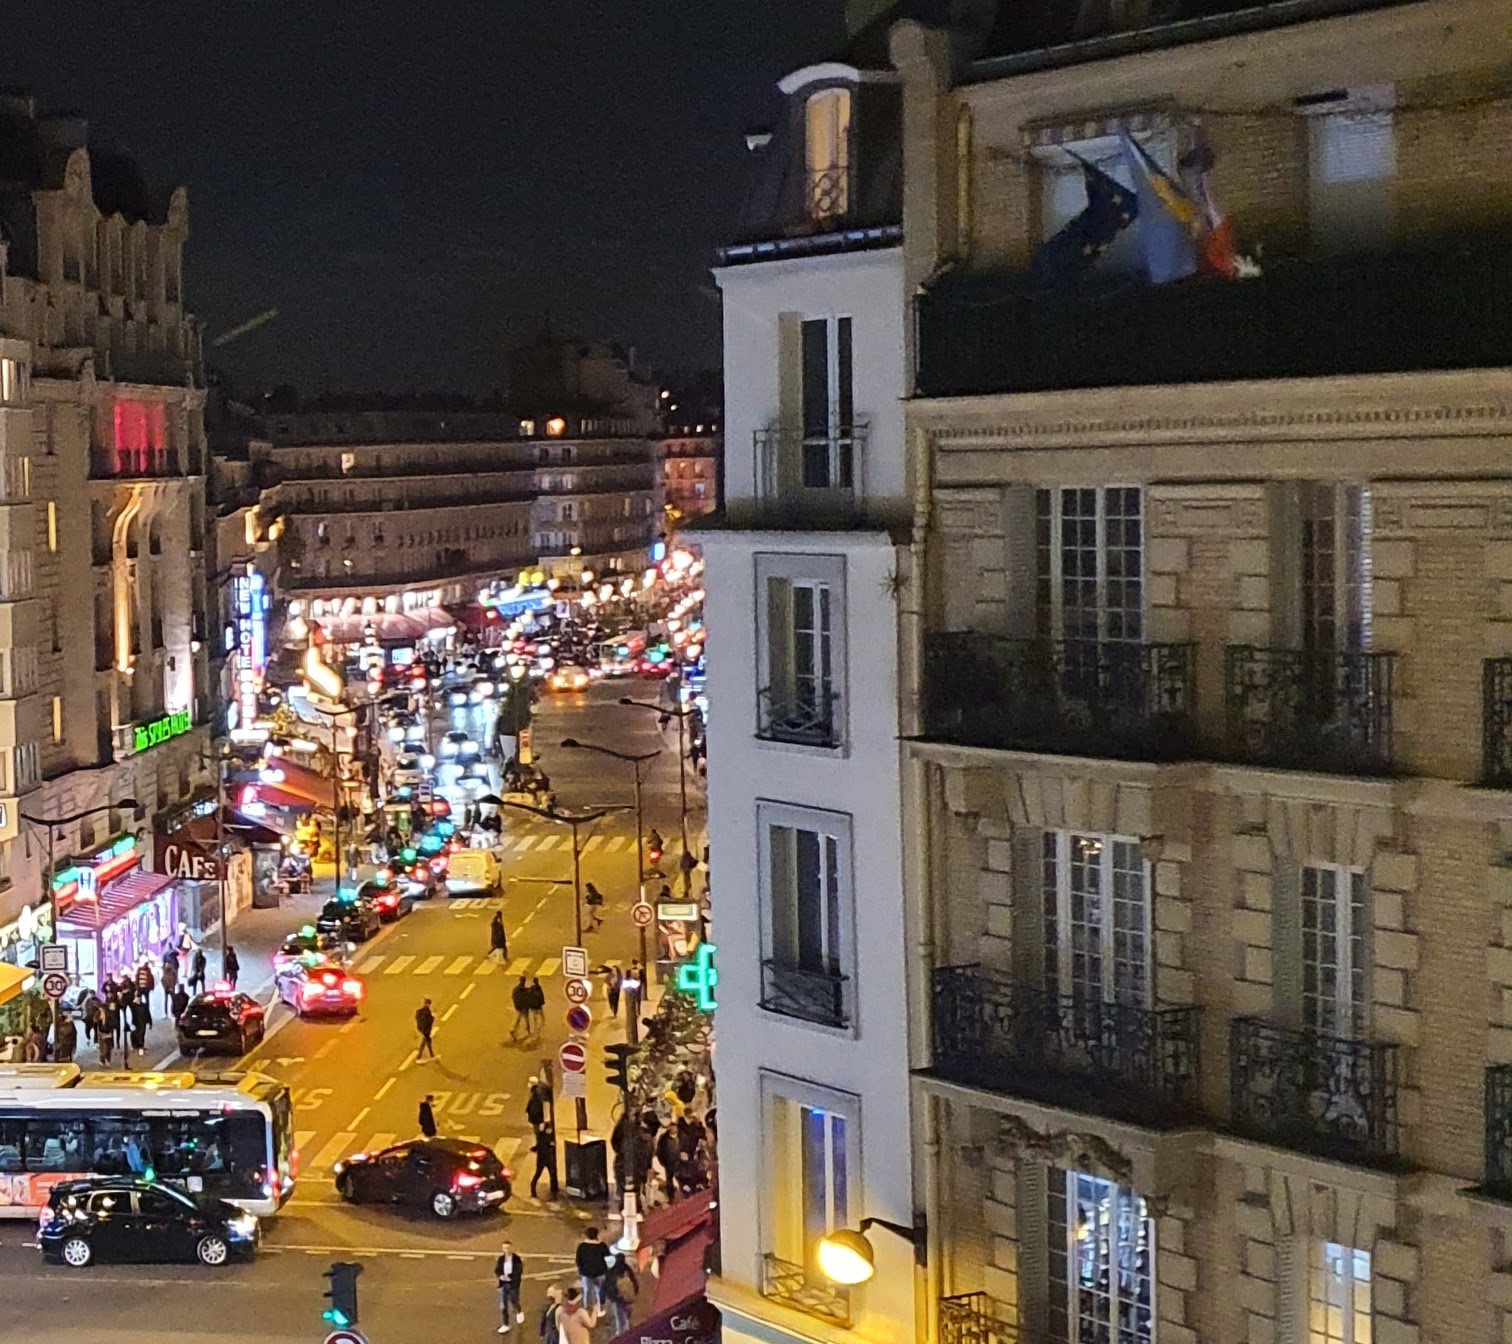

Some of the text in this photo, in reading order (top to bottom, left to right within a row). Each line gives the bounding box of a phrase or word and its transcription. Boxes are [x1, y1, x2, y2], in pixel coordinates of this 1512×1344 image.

[164, 845, 217, 879] CAFE
[47, 979, 64, 991] 30
[569, 985, 584, 997] 30
[432, 1091, 511, 1116] BUS
